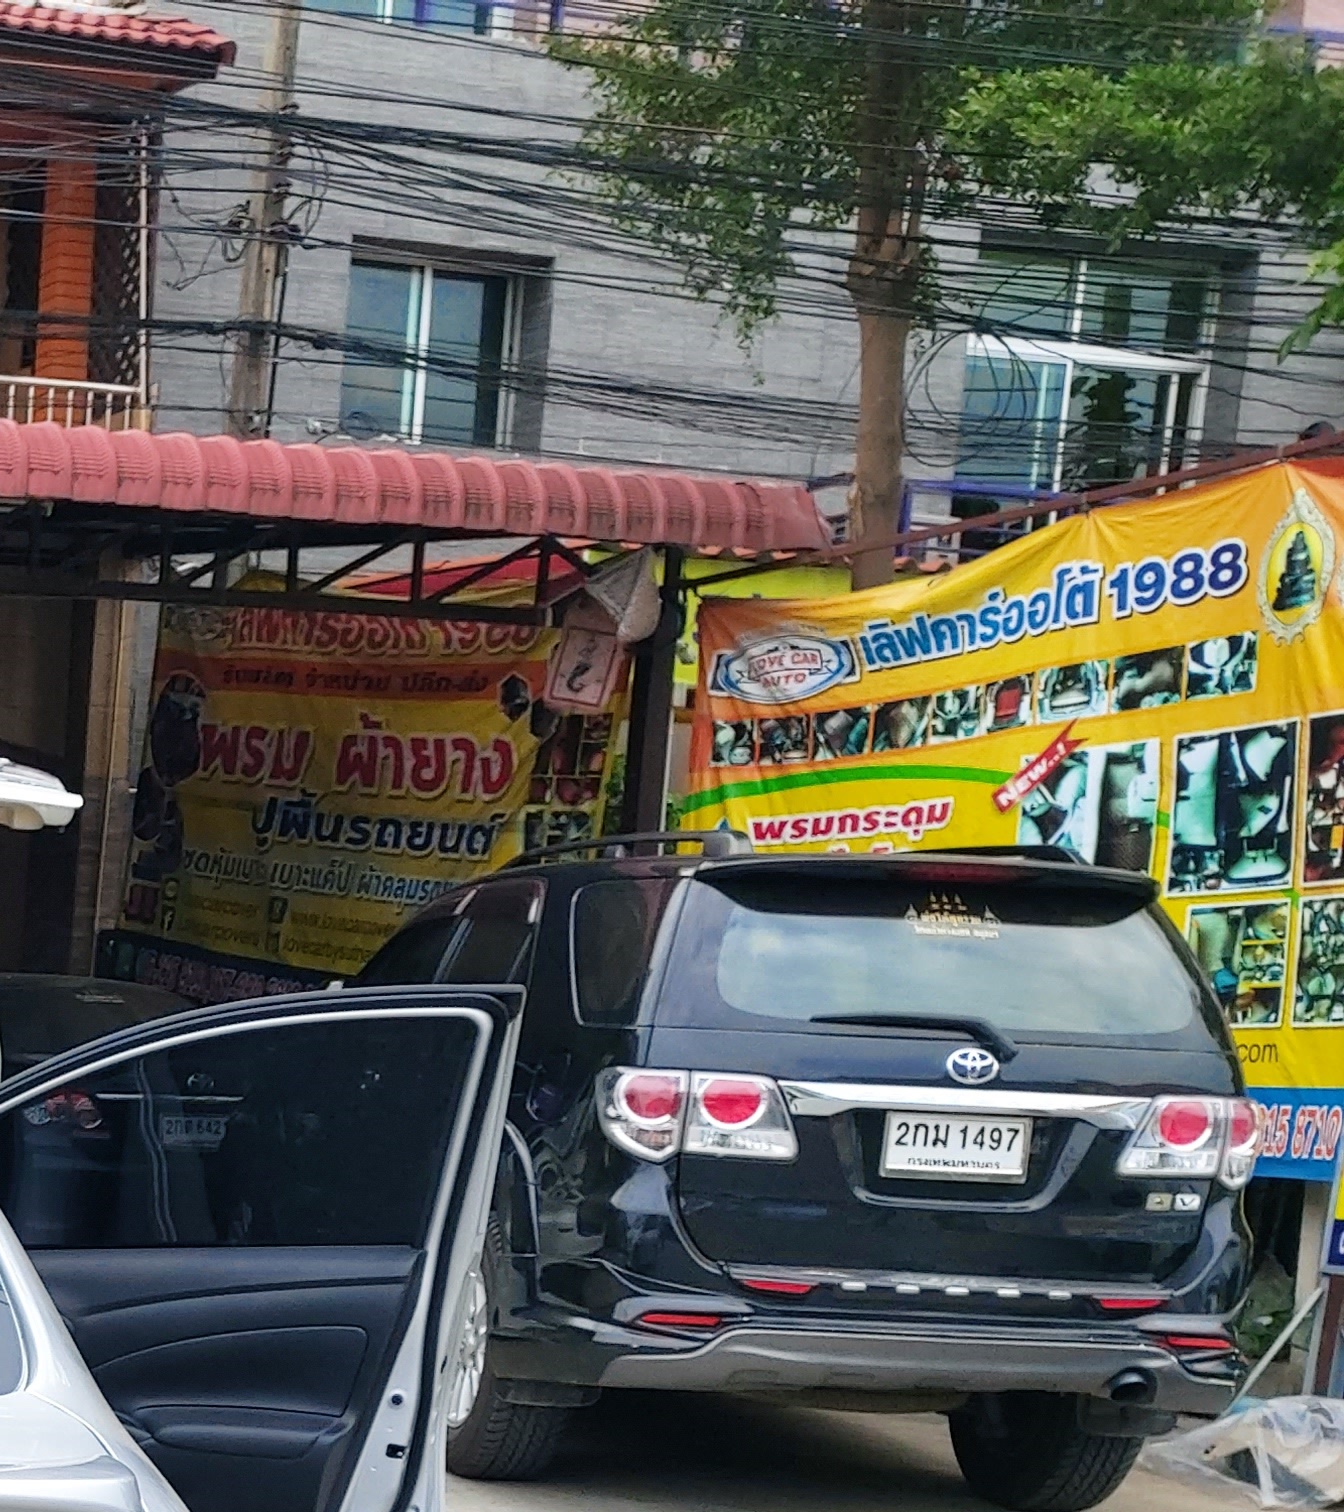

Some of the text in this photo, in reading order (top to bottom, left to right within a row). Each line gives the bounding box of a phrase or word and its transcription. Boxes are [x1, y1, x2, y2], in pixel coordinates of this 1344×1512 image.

[859, 541, 1244, 667] เลิฟคาร์ออโต้ 1988
[791, 651, 819, 666] CAR
[761, 672, 807, 687] AUTO
[200, 712, 513, 794] พรม ผ้ายาง
[752, 800, 952, 840] พรมกระดุม
[895, 1121, 1020, 1153] 2กม 1497
[1293, 1104, 1342, 1160] 8710
